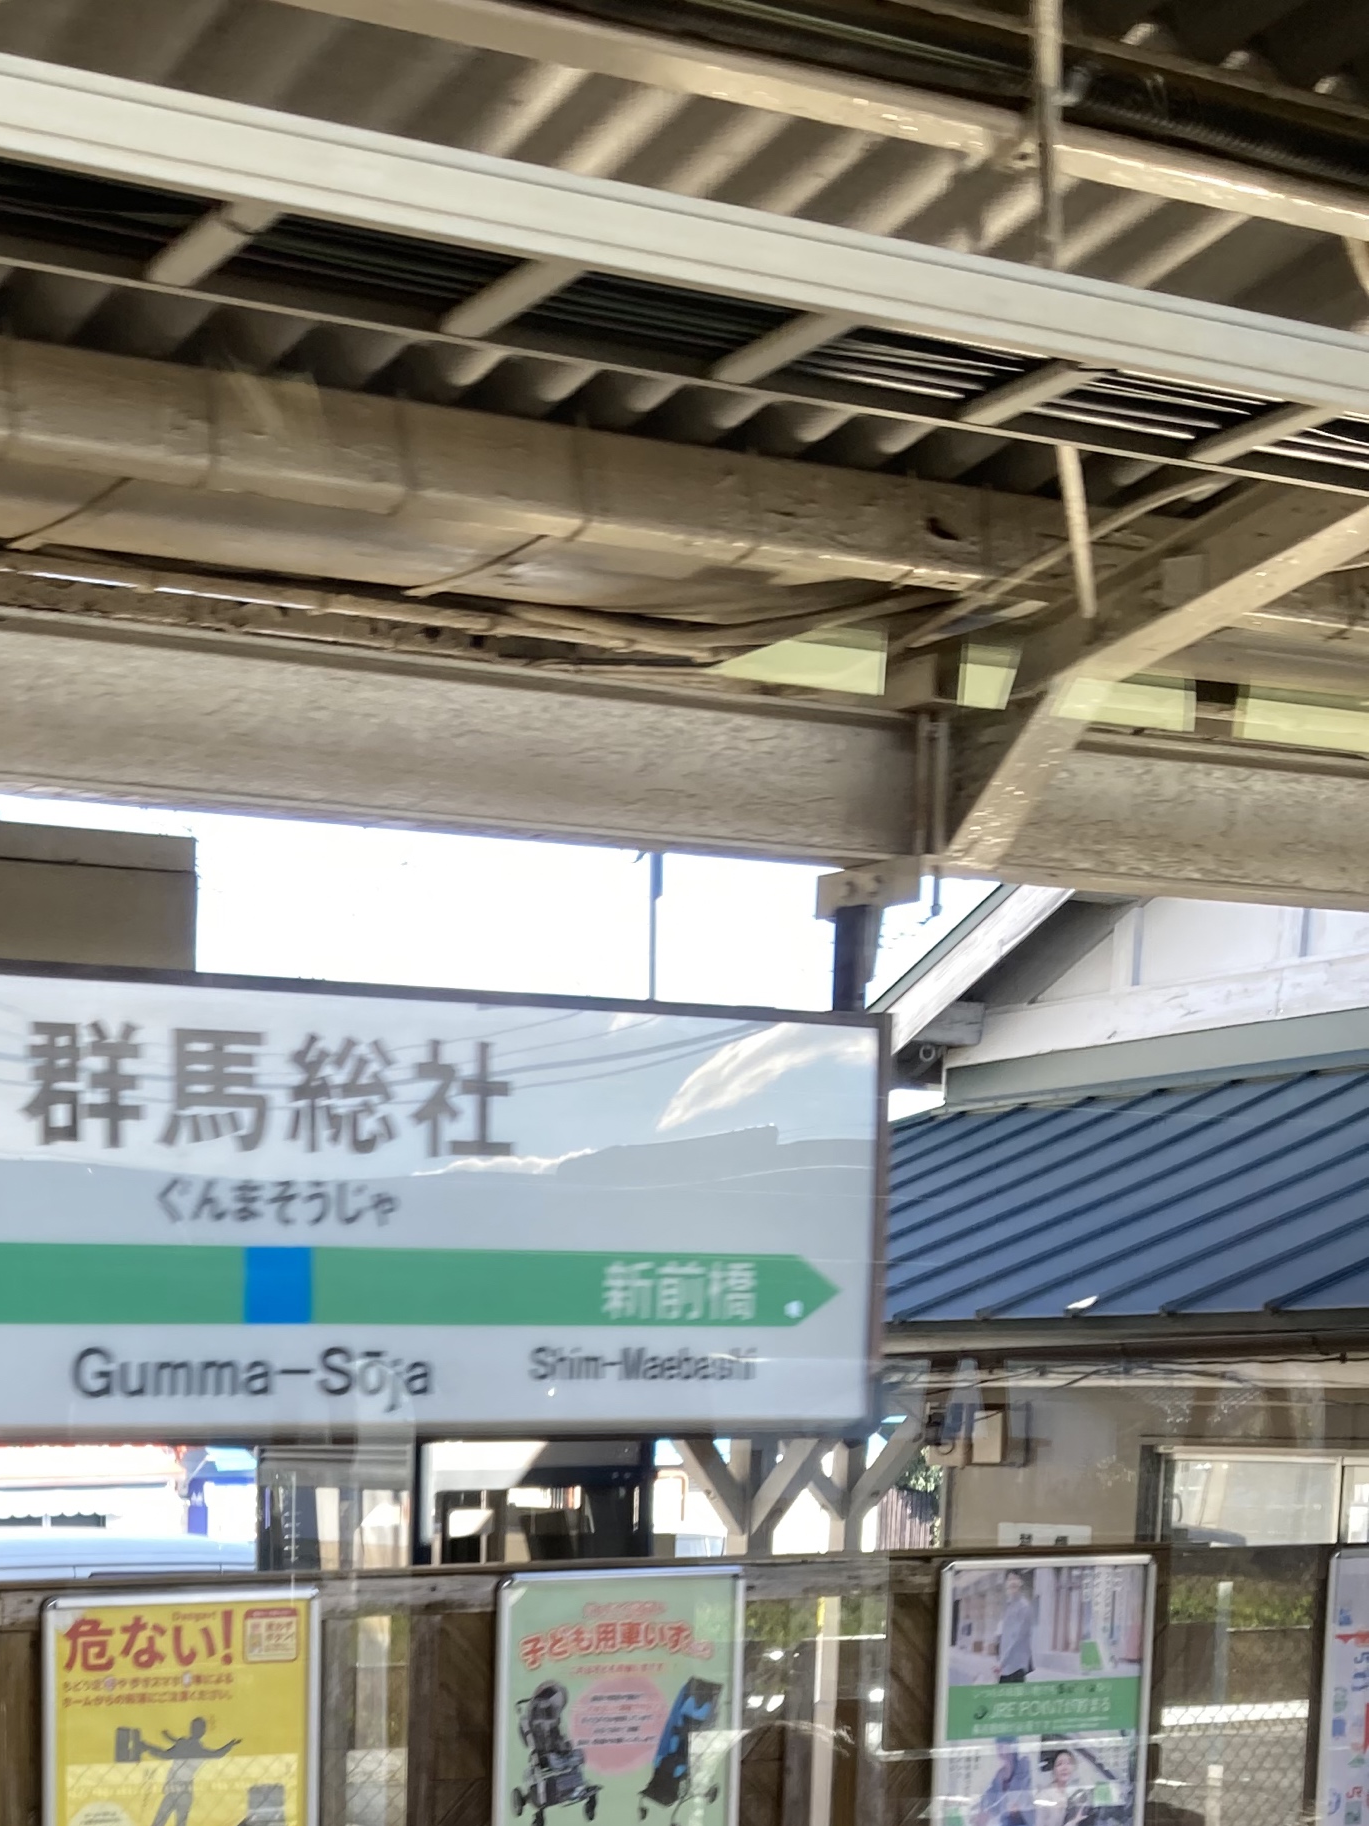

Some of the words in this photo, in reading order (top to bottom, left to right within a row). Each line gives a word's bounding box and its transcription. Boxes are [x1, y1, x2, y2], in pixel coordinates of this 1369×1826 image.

[20, 1020, 520, 1157] 群馬総社
[155, 1178, 401, 1228] ぐんまそうじゃ
[601, 1261, 758, 1322] 新前橋
[529, 1345, 757, 1384] Shin-Maebashi
[63, 1609, 234, 1672] 危ない!
